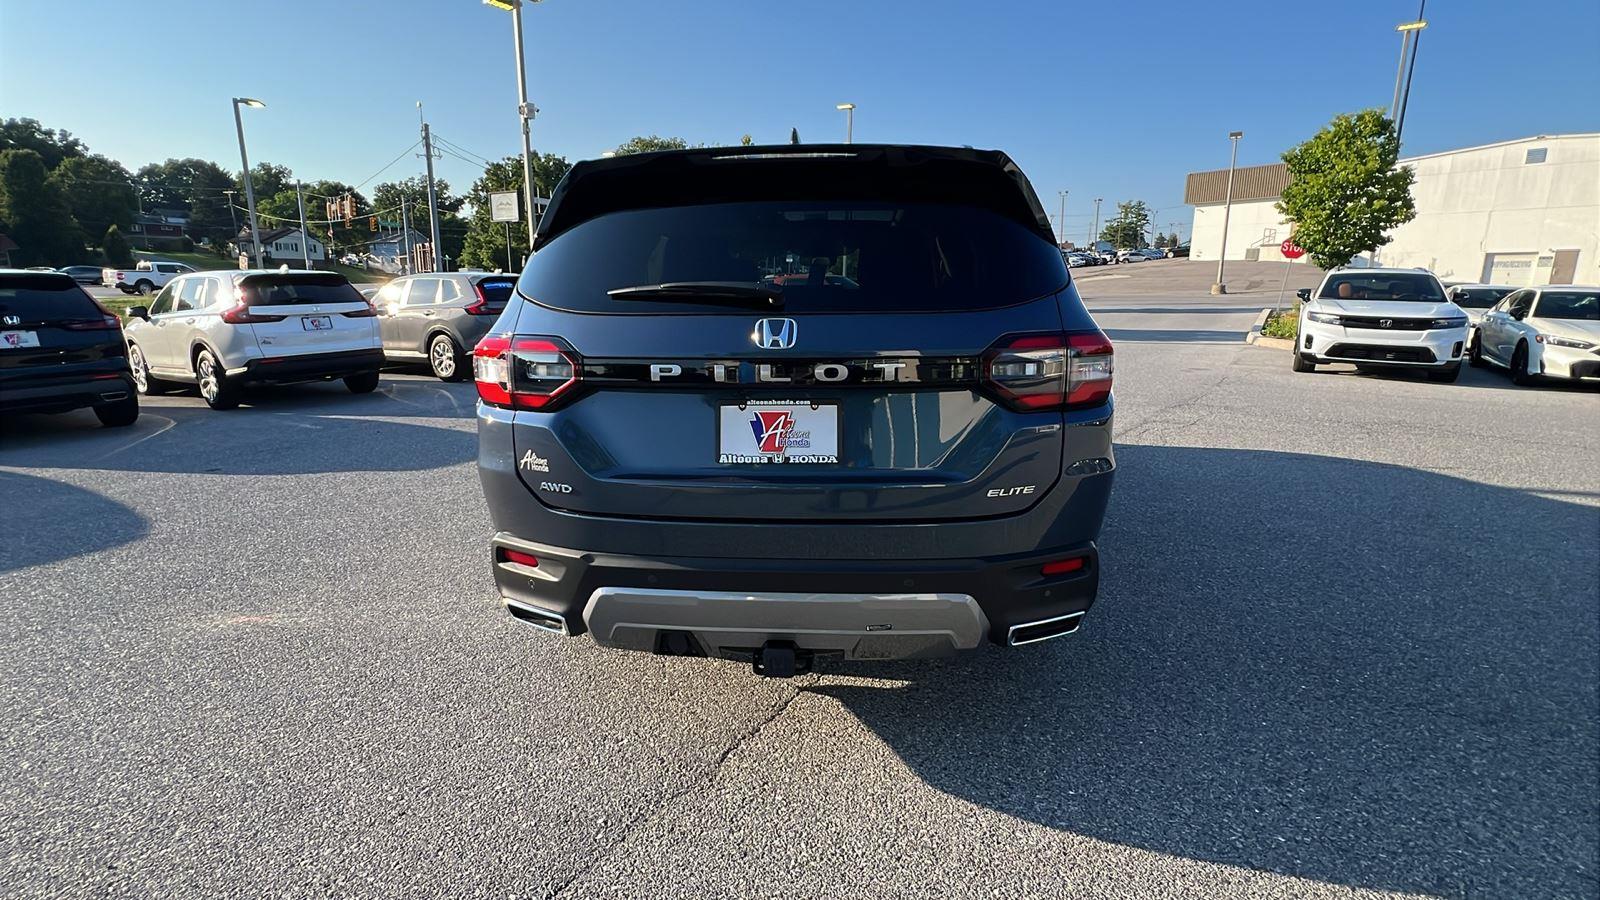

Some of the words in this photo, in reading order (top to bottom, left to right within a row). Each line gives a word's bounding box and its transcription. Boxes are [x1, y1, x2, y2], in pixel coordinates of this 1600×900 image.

[650, 364, 906, 382] PILOT
[780, 438, 810, 447] Honda
[719, 454, 768, 464] Altoona
[788, 455, 838, 464] HONDA
[540, 481, 573, 493] AWD
[987, 485, 1035, 497] ELITE
